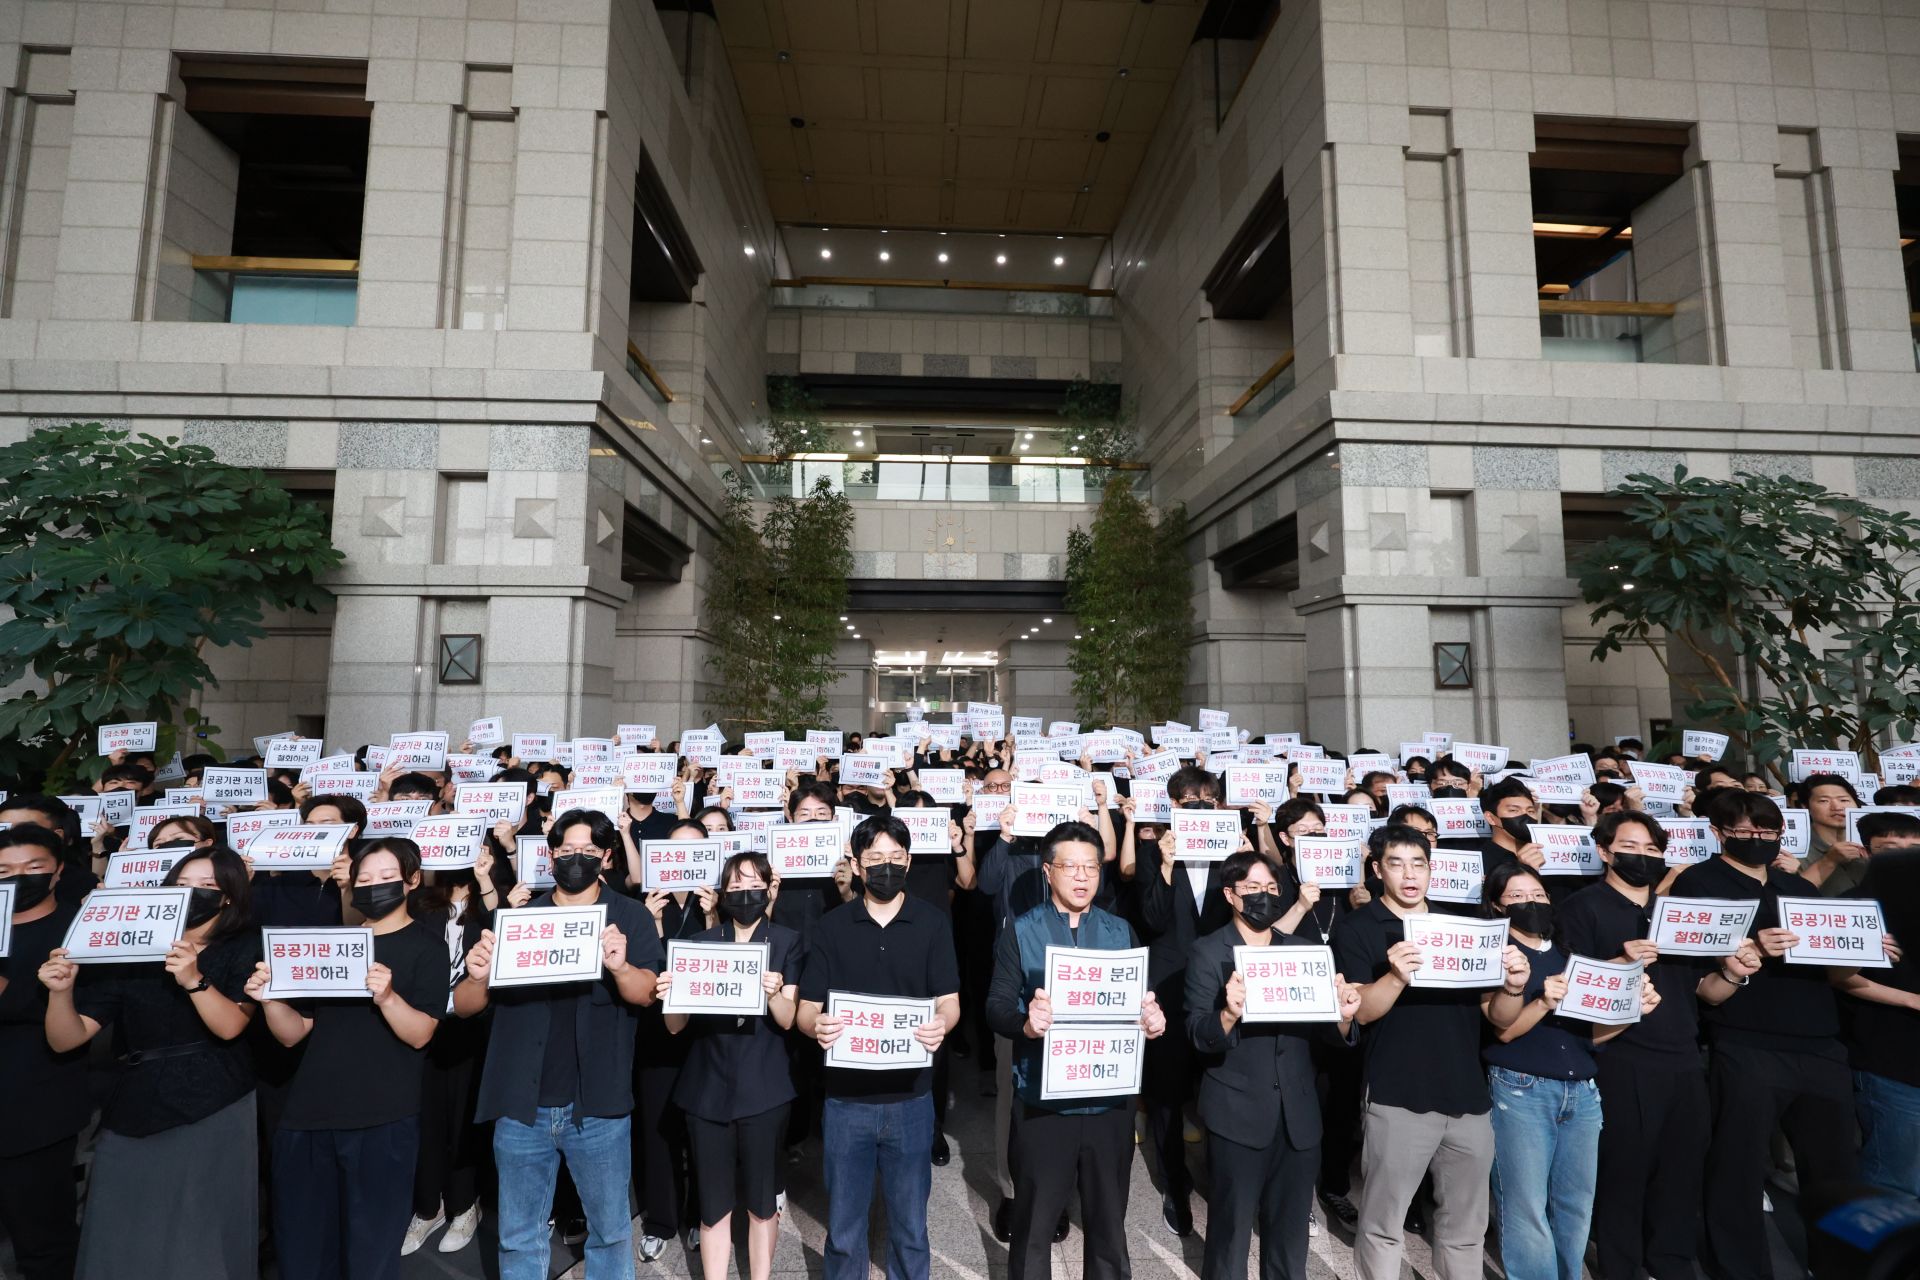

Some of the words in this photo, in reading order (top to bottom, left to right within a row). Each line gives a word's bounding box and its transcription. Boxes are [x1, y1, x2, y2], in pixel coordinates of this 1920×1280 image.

[424, 741, 443, 751] 지정
[207, 776, 240, 785] 공공기관
[244, 775, 262, 785] 지정
[317, 780, 353, 788] 공공기관
[737, 777, 760, 786] 금소원
[764, 777, 780, 786] 분리
[1265, 773, 1283, 782] 분리
[215, 789, 252, 798] 철회하라
[462, 792, 493, 803] 금소원
[498, 792, 519, 801] 분리
[742, 790, 774, 799] 철회하라
[1057, 794, 1078, 806] 분리
[372, 820, 412, 829] 철회하라
[902, 816, 928, 826] 공기관
[930, 814, 947, 826] 지정
[1179, 820, 1210, 831] 금소원
[1216, 821, 1236, 833] 분리
[232, 821, 262, 834] 금소원
[415, 826, 450, 838] 금소원
[457, 824, 481, 837] 분리
[1666, 828, 1705, 839] 비대위를
[274, 831, 328, 840] 비대위를
[776, 836, 809, 848] 금소원
[815, 835, 836, 846] 분리
[1548, 835, 1590, 846] 비대위를
[1186, 838, 1228, 849] 철회하라
[420, 845, 470, 858] 철회하라
[650, 851, 686, 863] 금소원
[692, 851, 716, 862] 분리
[1302, 848, 1343, 859] 공공기관
[1550, 852, 1592, 863] 구성하라
[1667, 846, 1707, 857] 구성하라
[785, 855, 828, 867] 철회하라
[1462, 862, 1480, 873] 지정
[659, 870, 707, 881] 철회하라
[1315, 866, 1354, 876] 철회하라
[82, 905, 140, 922] 공공기관
[144, 904, 177, 920] 지정
[1666, 910, 1712, 925] 금소원
[1719, 914, 1747, 925] 분리
[1790, 912, 1847, 928] 공공기관
[1851, 914, 1878, 929] 지정
[506, 923, 555, 941] 금소원
[563, 921, 594, 938] 분리
[88, 930, 154, 947] 철회하라
[1479, 934, 1501, 950] 지정
[1674, 931, 1732, 945] 철회하라
[1808, 935, 1864, 950] 철회하라
[273, 943, 330, 958] 공공기관
[336, 943, 364, 958] 지정
[516, 948, 580, 968] 철회하라
[1431, 955, 1487, 971] 철회하라
[675, 958, 728, 973] 공공기관
[732, 960, 759, 974] 지정
[1245, 962, 1297, 978] 공공기관
[1302, 962, 1327, 977] 지정
[291, 966, 349, 980] 철회하라
[1057, 965, 1102, 982] 금소원
[1110, 966, 1138, 982] 분리
[1575, 971, 1621, 990] 금소원
[1626, 974, 1642, 991] 분리
[689, 981, 742, 997] 철회하라
[1262, 986, 1315, 1002] 철회하라
[1067, 991, 1126, 1006] 철회하라
[1580, 994, 1632, 1012] 철회하라
[840, 1010, 884, 1029] 금소원
[893, 1013, 922, 1030] 분리
[850, 1036, 911, 1055] 철회하라
[1051, 1040, 1105, 1056] 공공기관
[1109, 1039, 1135, 1055] 지정
[1066, 1064, 1119, 1080] 철회하라
